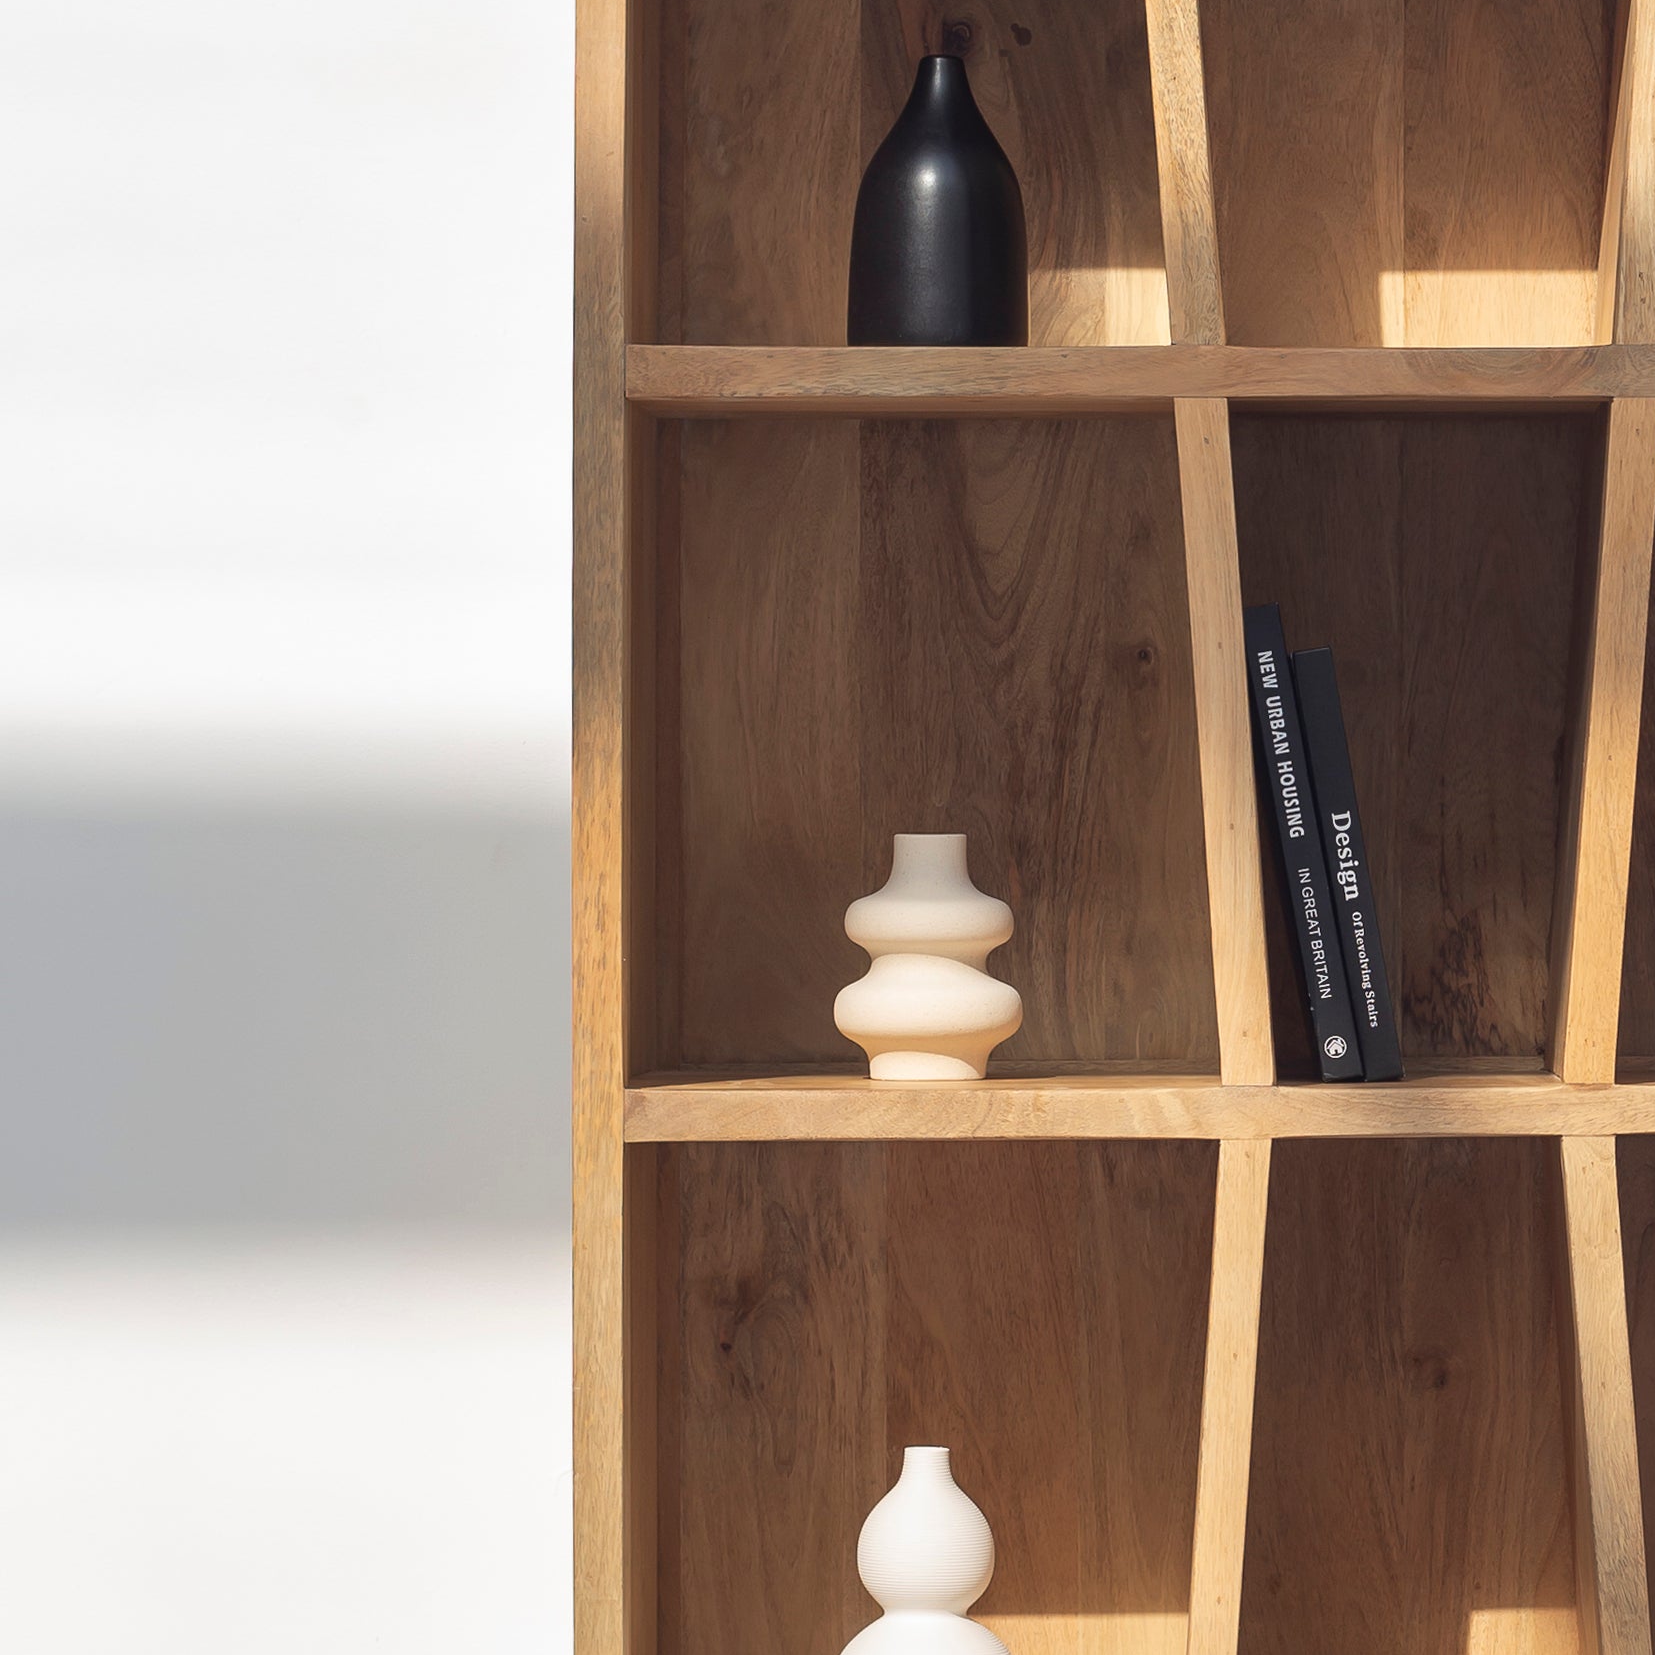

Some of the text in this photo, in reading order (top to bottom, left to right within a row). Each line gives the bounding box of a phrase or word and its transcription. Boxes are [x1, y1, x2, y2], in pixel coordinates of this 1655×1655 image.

[1257, 650, 1305, 839] NEW URBAN HOUSING
[1331, 810, 1360, 901] Design
[1298, 867, 1333, 1000] IN GREAT BRITAIN
[1351, 911, 1379, 1029] Of Revolving Stairs
